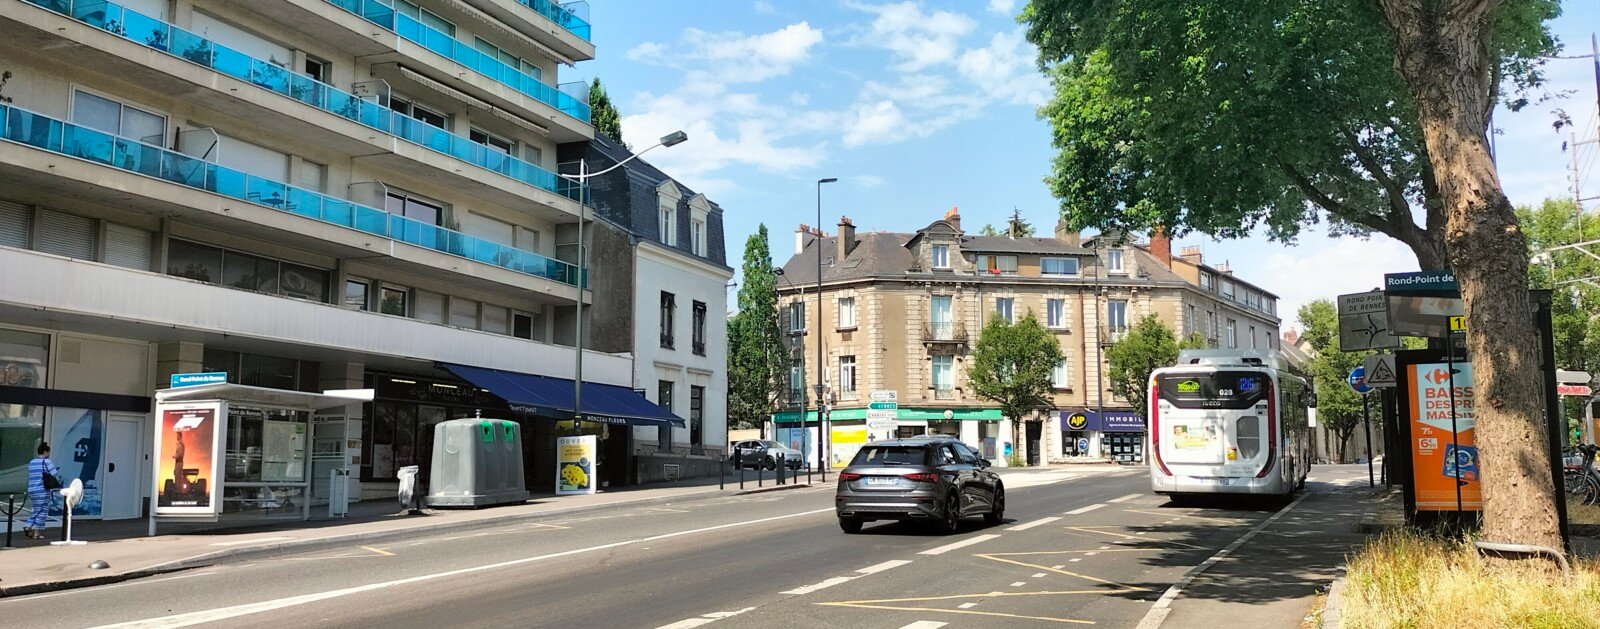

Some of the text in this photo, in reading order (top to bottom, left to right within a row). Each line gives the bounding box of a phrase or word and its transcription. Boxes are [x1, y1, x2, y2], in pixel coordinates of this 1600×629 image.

[1388, 274, 1454, 286] Rond-Point de
[1346, 296, 1365, 304] ROND
[1360, 302, 1386, 310] RENNES
[428, 384, 474, 397] MONCEAU
[1425, 400, 1451, 410] DES
[587, 415, 607, 423] MONCEAU
[1071, 415, 1086, 427] AJP
[1156, 476, 1164, 486] 70
